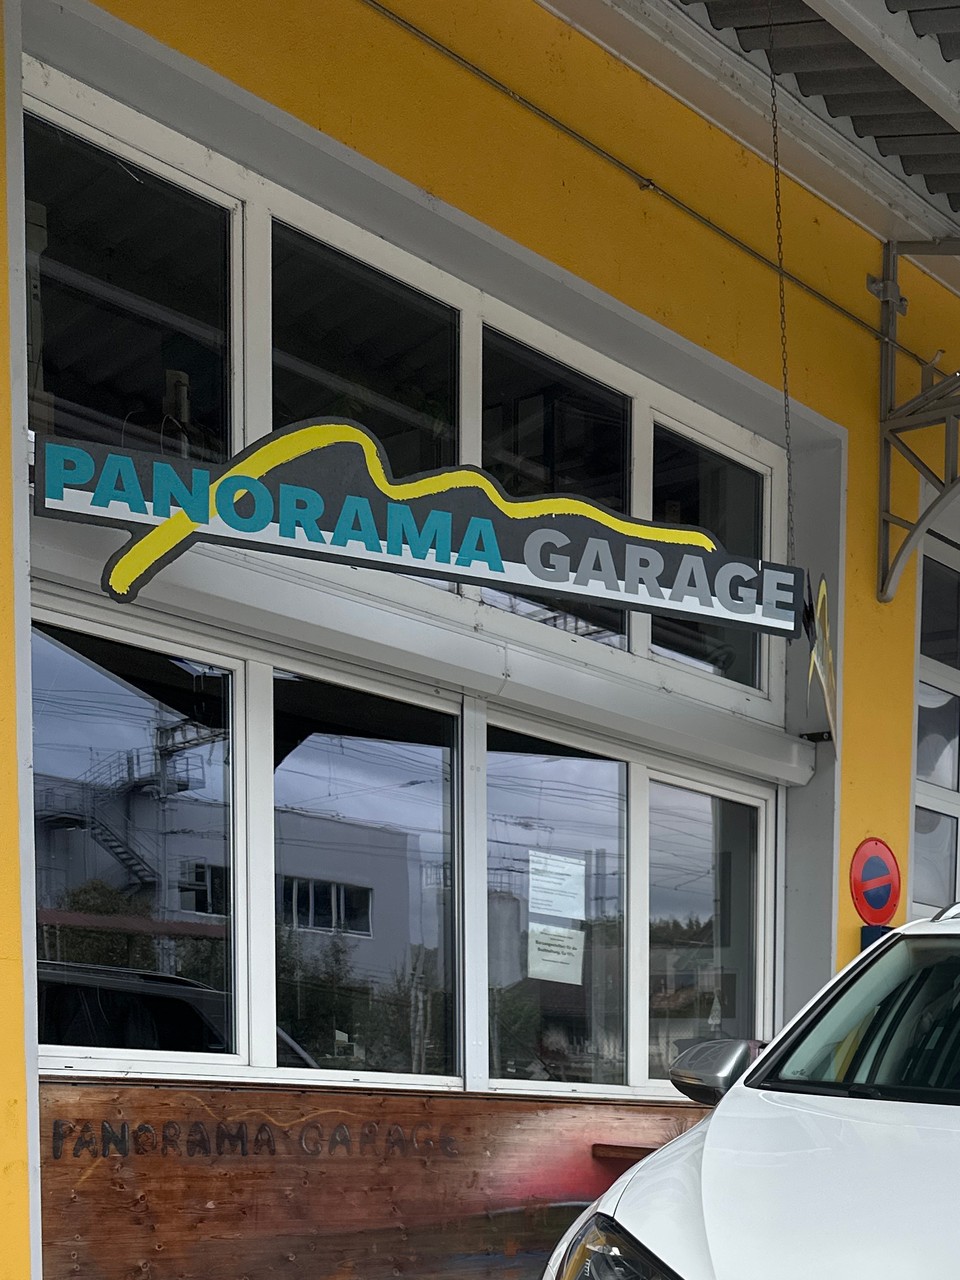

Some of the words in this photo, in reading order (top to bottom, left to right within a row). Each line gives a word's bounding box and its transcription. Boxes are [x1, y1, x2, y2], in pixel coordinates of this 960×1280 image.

[44, 442, 505, 574] PANORAMA
[523, 528, 801, 622] GARAGE
[52, 1119, 276, 1160] PANORAMA
[301, 1122, 459, 1158] GARAGE
